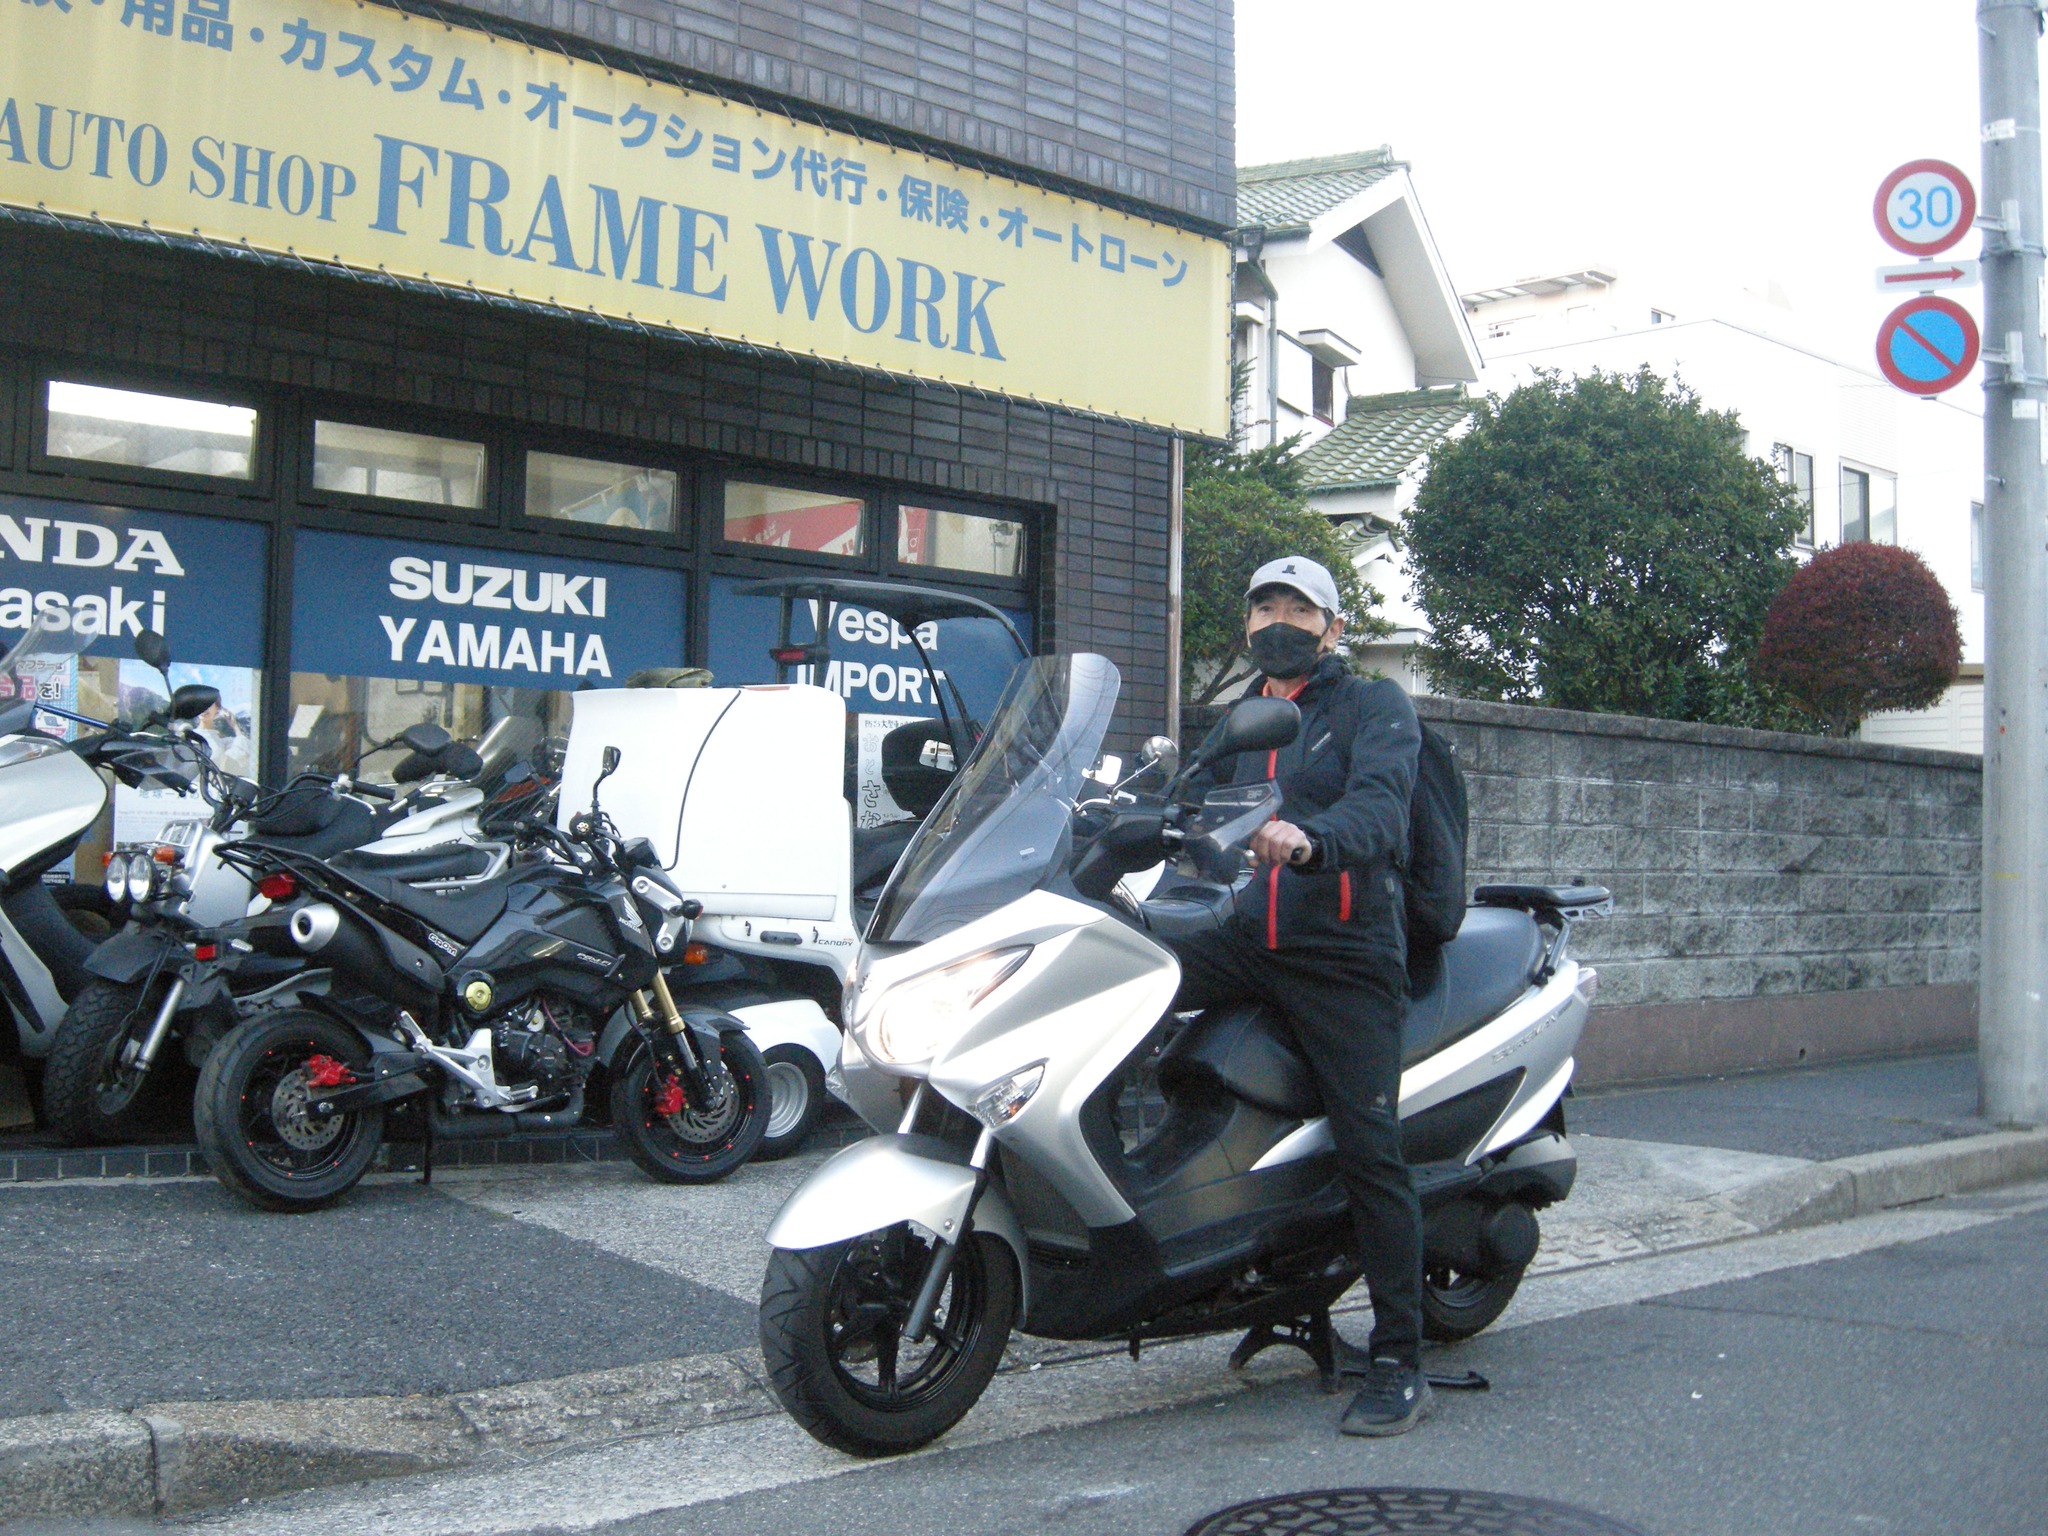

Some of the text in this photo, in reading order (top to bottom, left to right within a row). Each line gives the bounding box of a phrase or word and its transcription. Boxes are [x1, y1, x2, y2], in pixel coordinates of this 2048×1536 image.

[0, 97, 1006, 362] AUTO SHOP FRAME WORK
[1897, 185, 1954, 230] 30
[389, 556, 607, 618] SUZUKI
[378, 615, 612, 678] YAMAHA
[428, 932, 458, 957] GROM
[618, 916, 641, 934] HONDA
[818, 939, 854, 947] CANOPY
